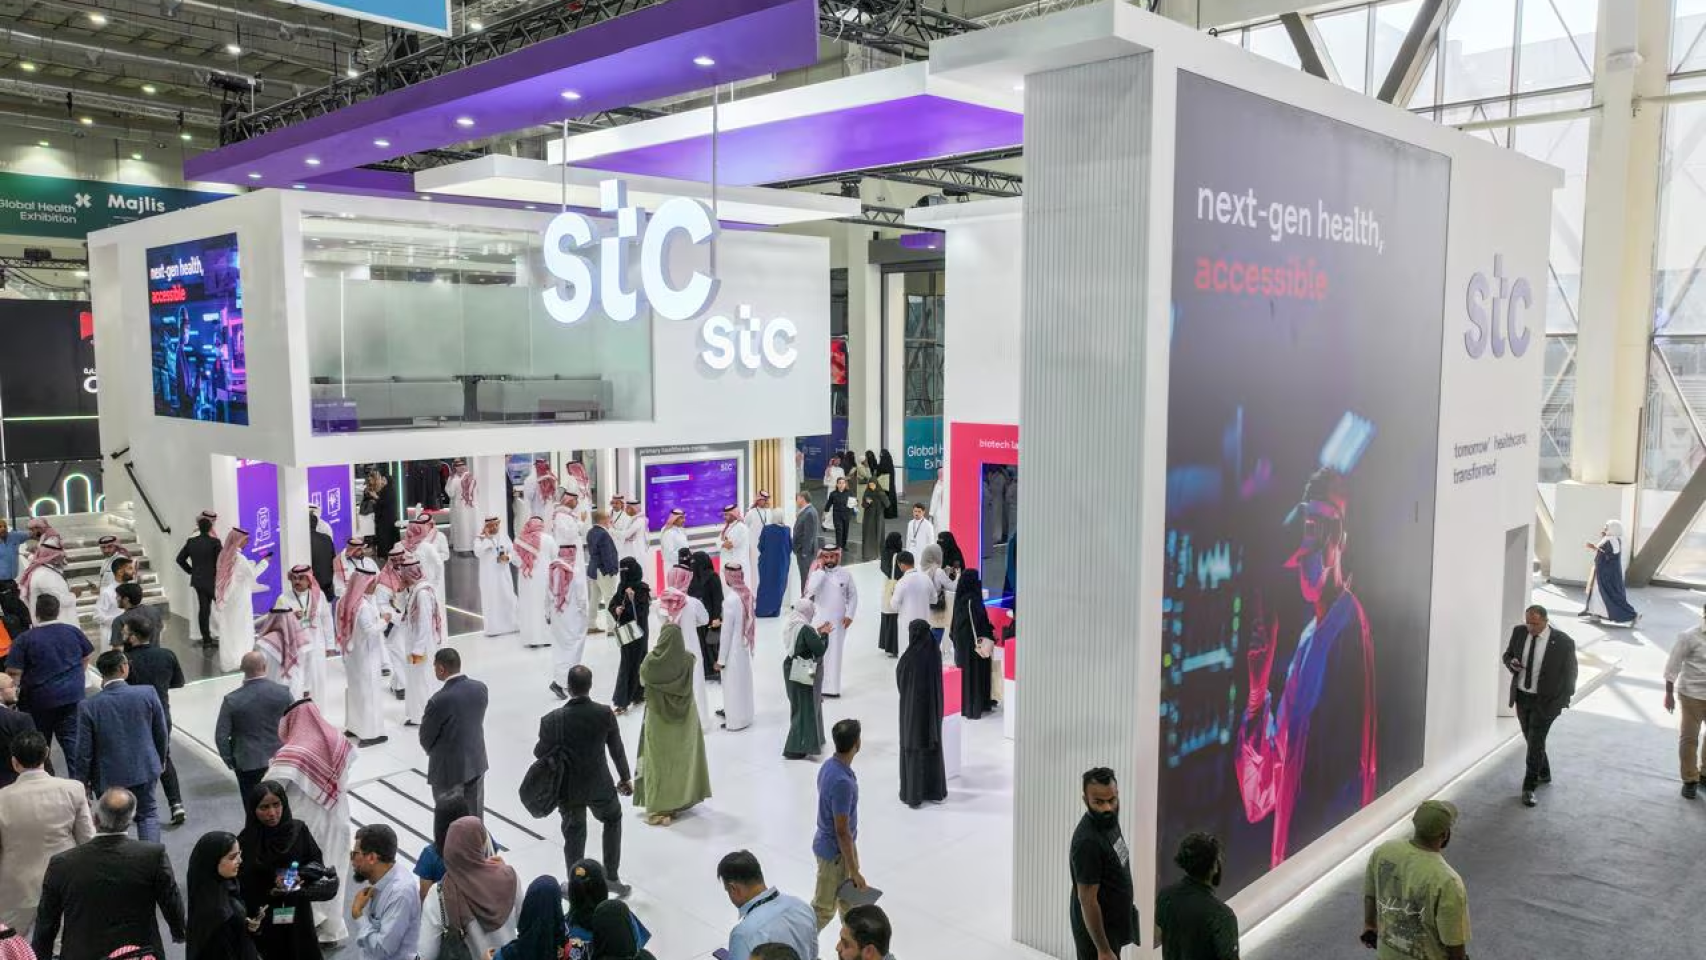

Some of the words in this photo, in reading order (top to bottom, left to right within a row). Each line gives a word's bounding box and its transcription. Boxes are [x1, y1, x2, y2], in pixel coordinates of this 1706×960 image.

[38, 202, 76, 214] Health
[107, 193, 166, 214] Majlis
[20, 211, 76, 224] Exhibition
[1197, 187, 1311, 242] next-gen
[1317, 198, 1385, 255] health,
[542, 179, 721, 323] stc
[1194, 256, 1329, 300] accessible
[1464, 253, 1532, 360] stc
[703, 304, 798, 369] stc
[907, 443, 937, 457] Global
[979, 439, 1010, 449] biotech
[1453, 459, 1496, 484] transformed
